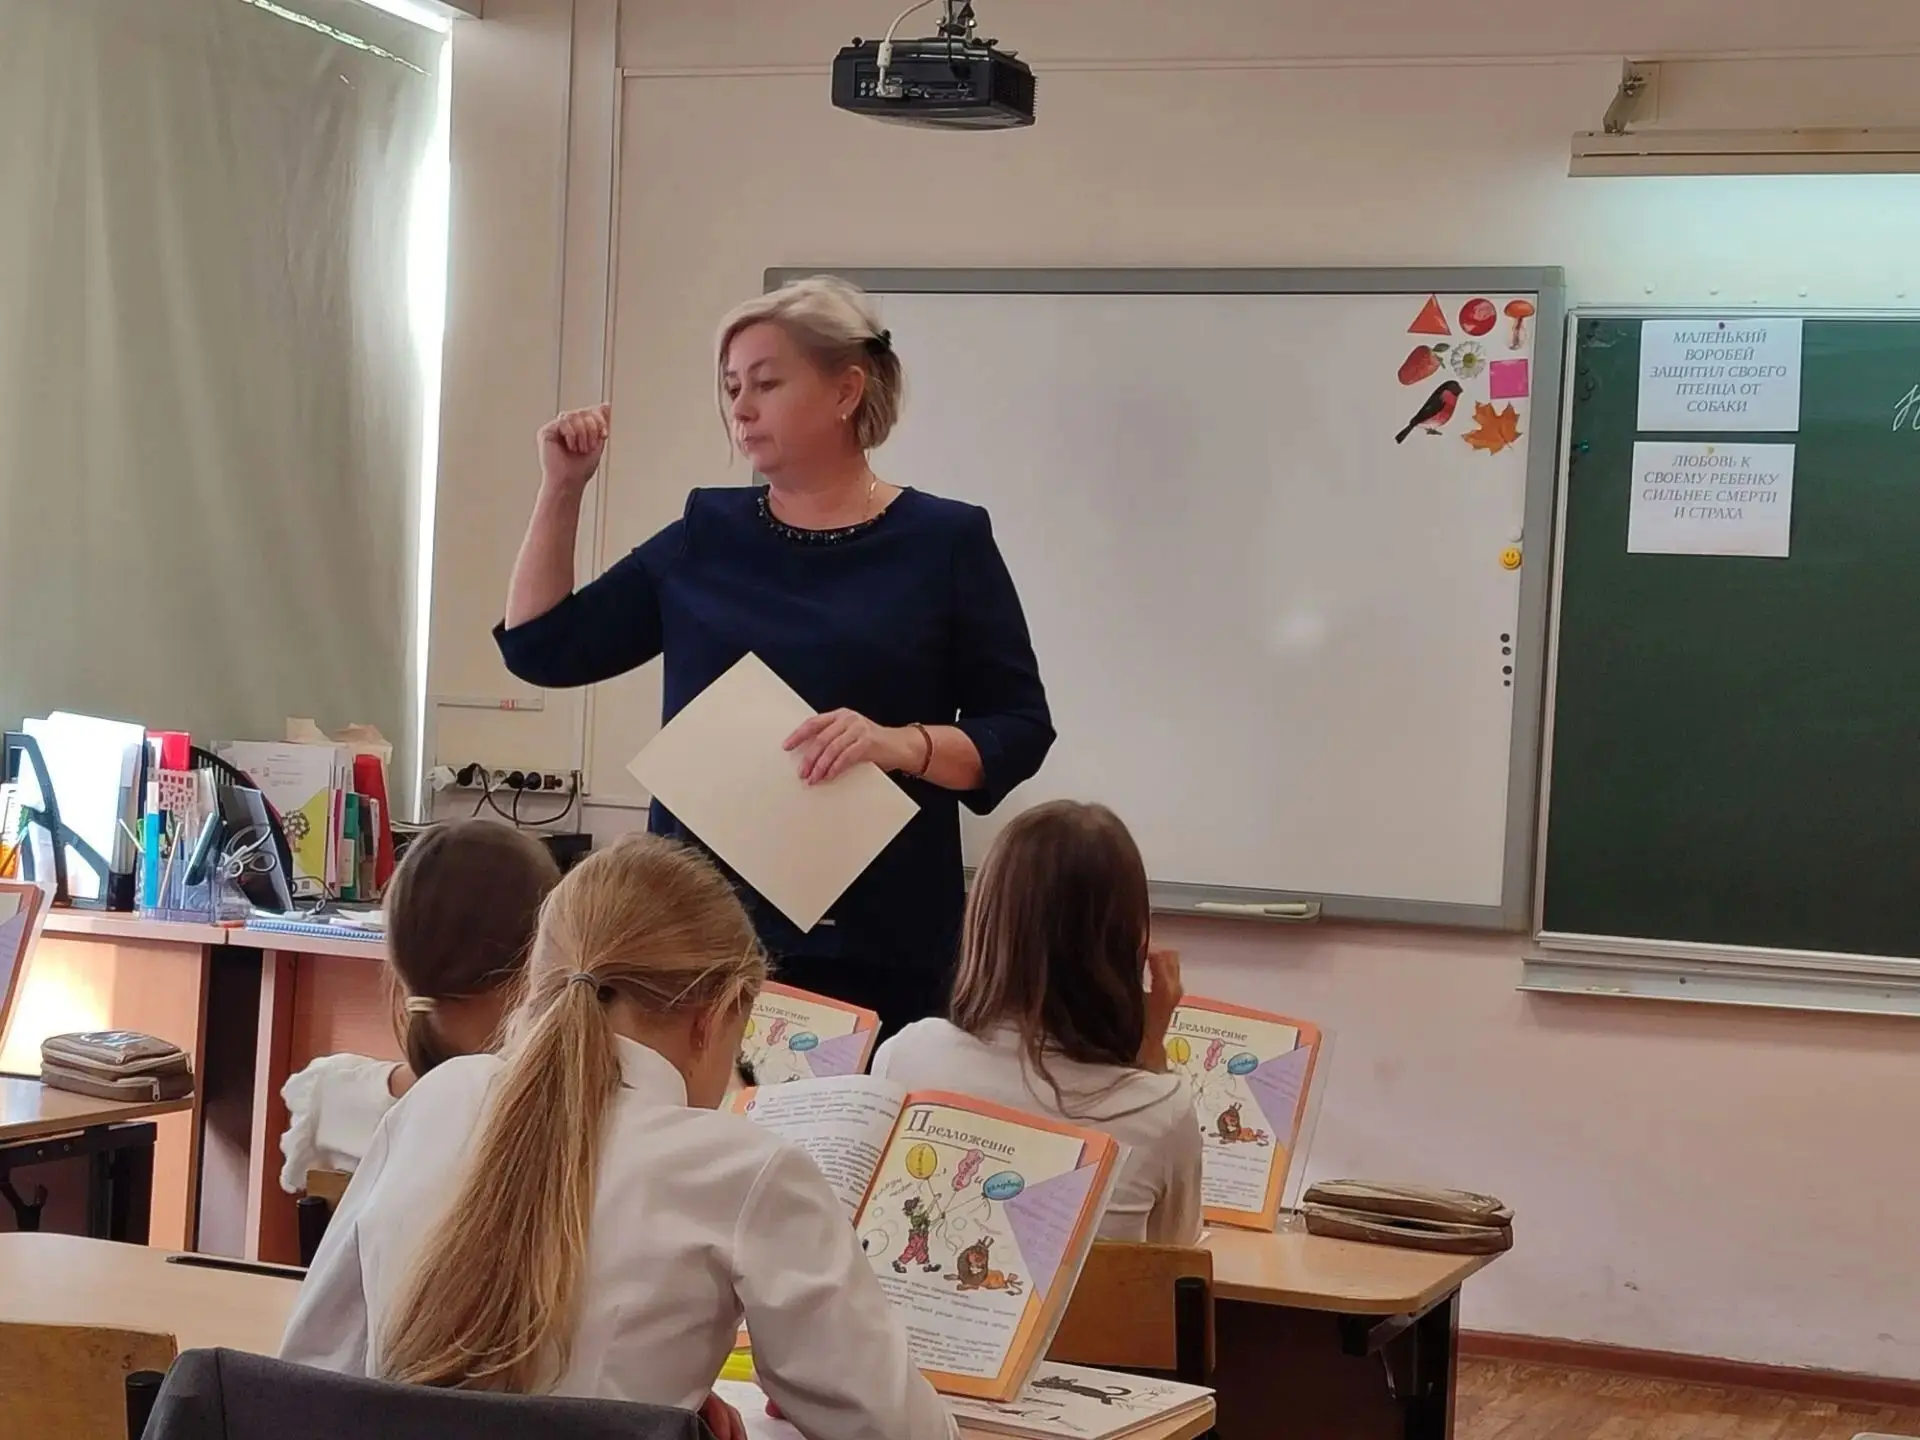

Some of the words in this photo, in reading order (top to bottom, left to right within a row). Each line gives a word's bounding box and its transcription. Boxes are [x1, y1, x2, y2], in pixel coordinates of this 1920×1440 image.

[1673, 329, 1767, 344] МАЛЕНЬКИЙ
[1685, 347, 1755, 361] ВОРОБЕЙ
[1650, 366, 1724, 379] ЗАЩИТИЛ
[1728, 366, 1787, 378] СВОЕГО
[1676, 383, 1736, 397] ПТЕНЦА
[1740, 383, 1761, 396] ОТ
[1687, 400, 1748, 413] СОБАКИ
[1672, 455, 1736, 468] ЛЮБОВЬ
[1740, 456, 1751, 468] К
[1644, 472, 1706, 485] СВОЕМУ
[1710, 473, 1780, 486] РЕБЕНКУ
[1642, 489, 1712, 502] СИЛЬНЕЕ
[1716, 491, 1778, 504] СМЕРТИ
[1674, 507, 1684, 519] И
[1689, 507, 1743, 520] СТРАХА
[904, 1109, 1016, 1156] Предложение
